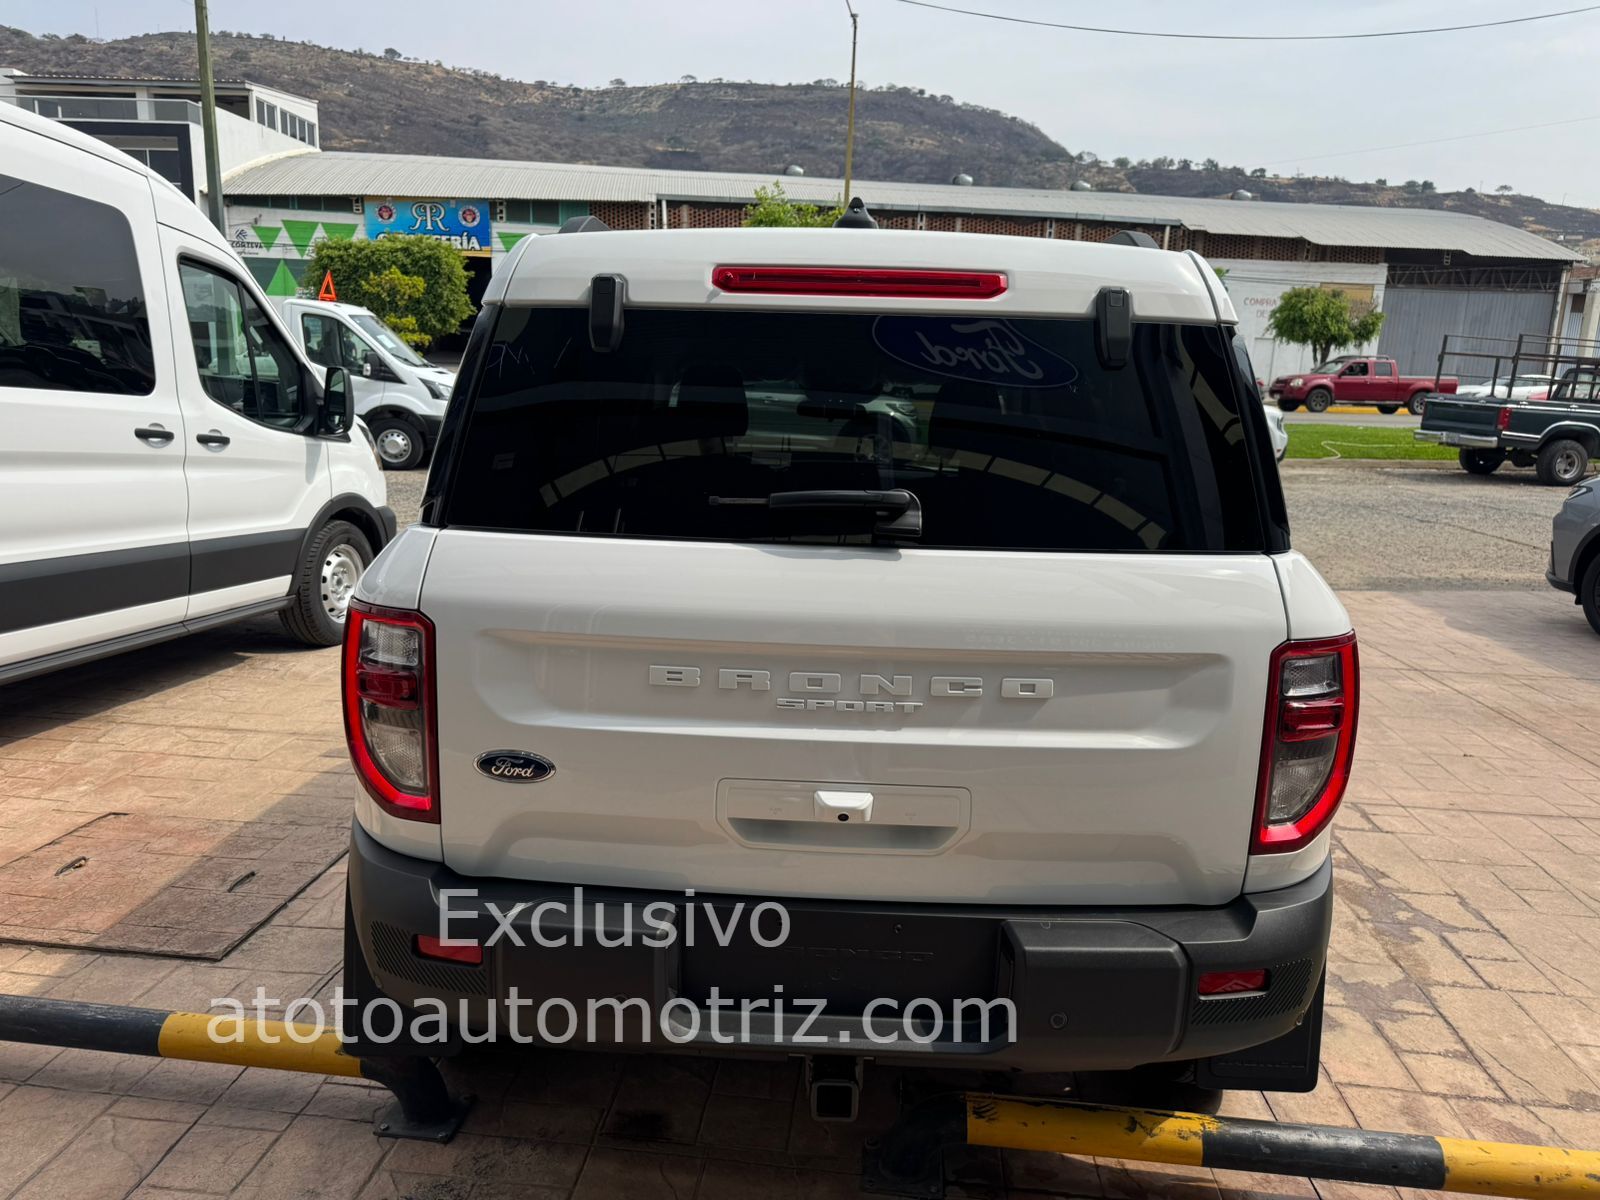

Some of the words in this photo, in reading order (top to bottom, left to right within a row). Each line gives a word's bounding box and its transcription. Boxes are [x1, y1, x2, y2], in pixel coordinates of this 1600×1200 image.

[649, 664, 1054, 699] BRONCO
[776, 697, 924, 714] SPORT
[491, 757, 536, 777] Ford
